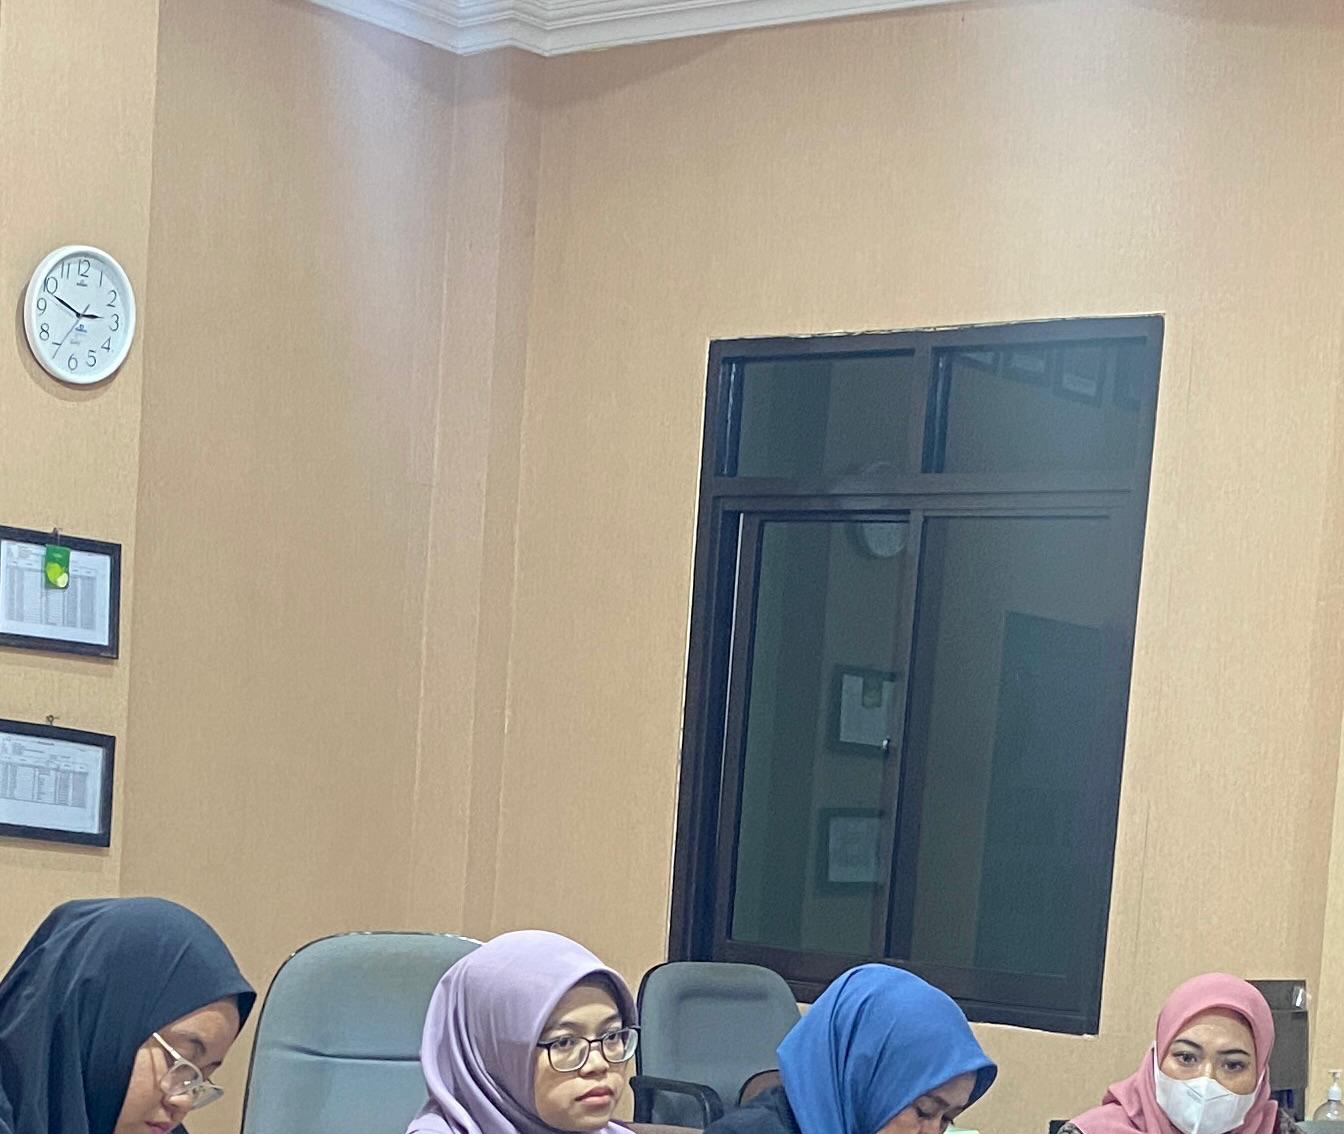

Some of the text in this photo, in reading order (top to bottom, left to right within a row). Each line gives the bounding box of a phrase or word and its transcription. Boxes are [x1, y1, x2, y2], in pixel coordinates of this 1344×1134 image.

[60, 261, 71, 279] 11
[77, 259, 91, 277] 12
[43, 276, 58, 295] 10
[36, 297, 47, 316] 9
[106, 290, 116, 307] 2
[109, 313, 119, 332] 3
[39, 323, 50, 341] 8
[100, 337, 111, 353] 4
[67, 353, 78, 371] 6
[86, 349, 97, 367] 5
